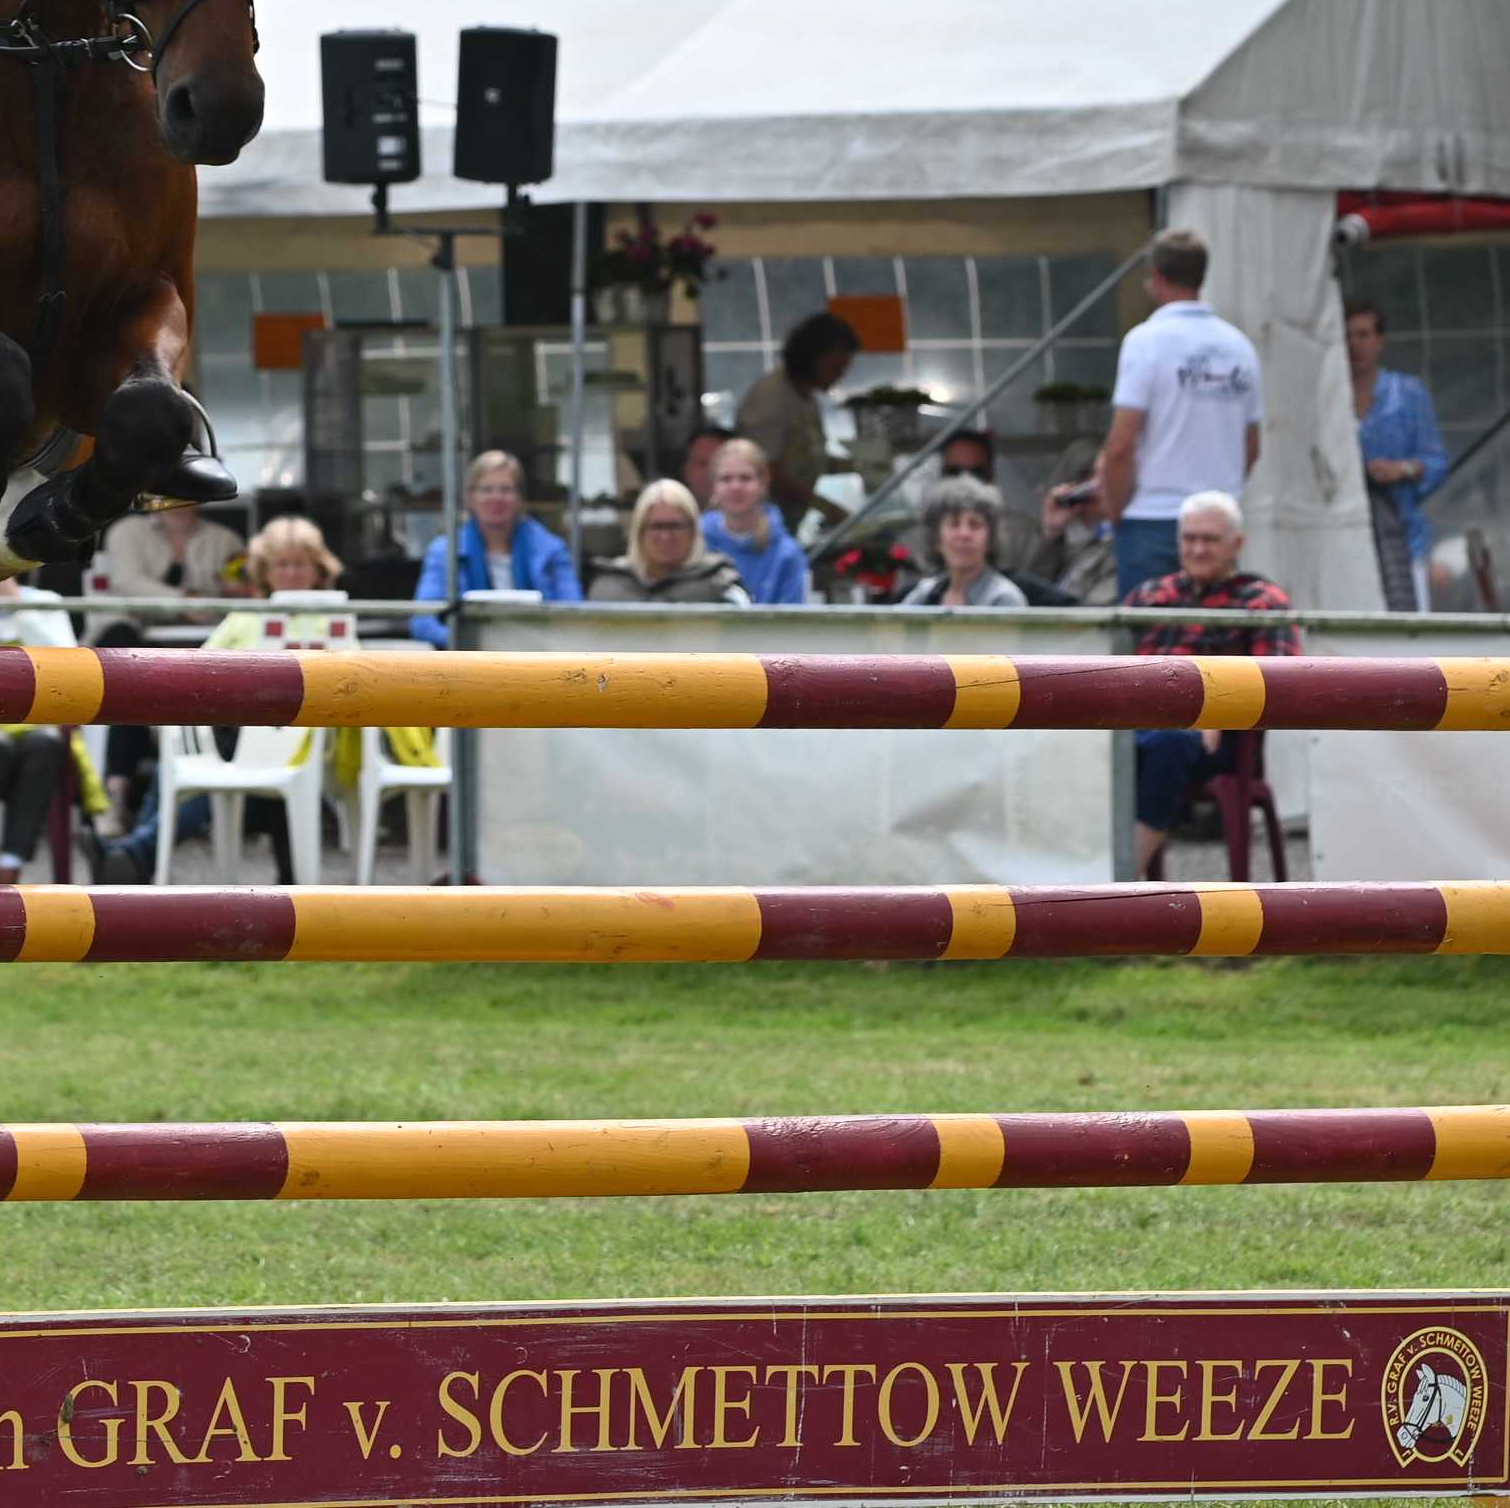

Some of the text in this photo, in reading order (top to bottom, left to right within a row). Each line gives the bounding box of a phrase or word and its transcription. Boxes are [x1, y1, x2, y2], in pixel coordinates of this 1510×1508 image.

[57, 1376, 316, 1469] GRAF
[342, 1400, 403, 1460] v.
[437, 1361, 1030, 1458] SCHMETTOW
[1052, 1358, 1356, 1444] WEEZE
[1387, 1353, 1407, 1393] GRAF
[1419, 1333, 1482, 1379] SCHMETTOW
[1467, 1385, 1483, 1430] WEEZE
